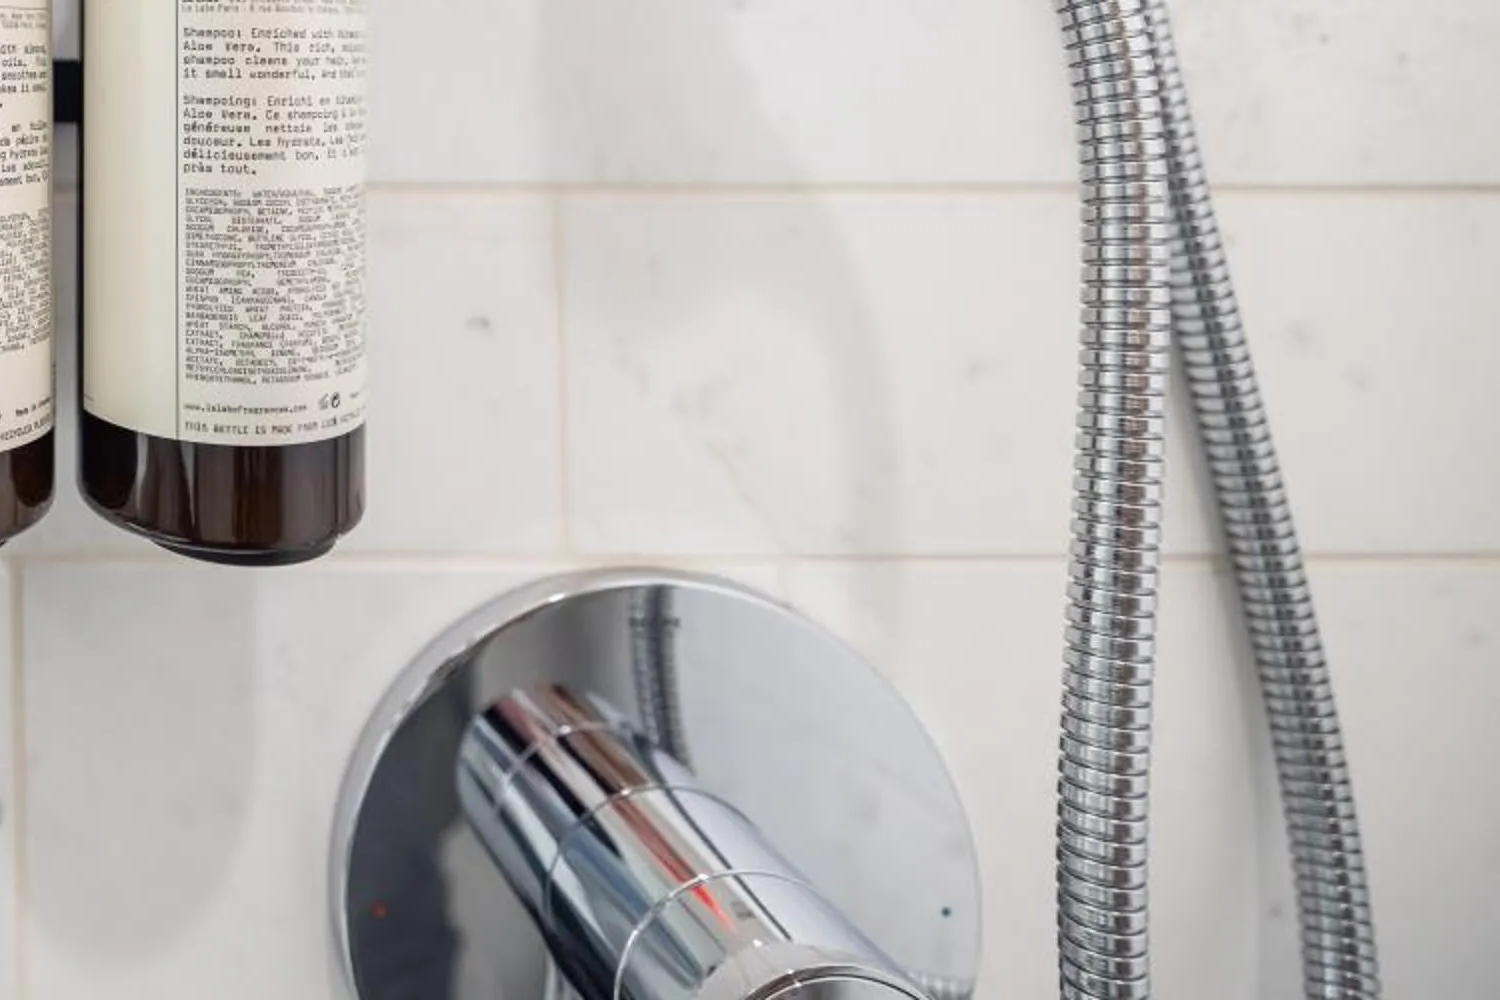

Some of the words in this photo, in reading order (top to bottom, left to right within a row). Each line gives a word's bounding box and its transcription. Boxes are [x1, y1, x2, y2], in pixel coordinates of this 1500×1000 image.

[251, 28, 305, 39] Enriched
[274, 42, 300, 52] This
[246, 55, 287, 65] cleans
[184, 68, 196, 78] it
[206, 68, 242, 78] smell
[184, 108, 212, 118] Aloe
[265, 110, 280, 120] Ce
